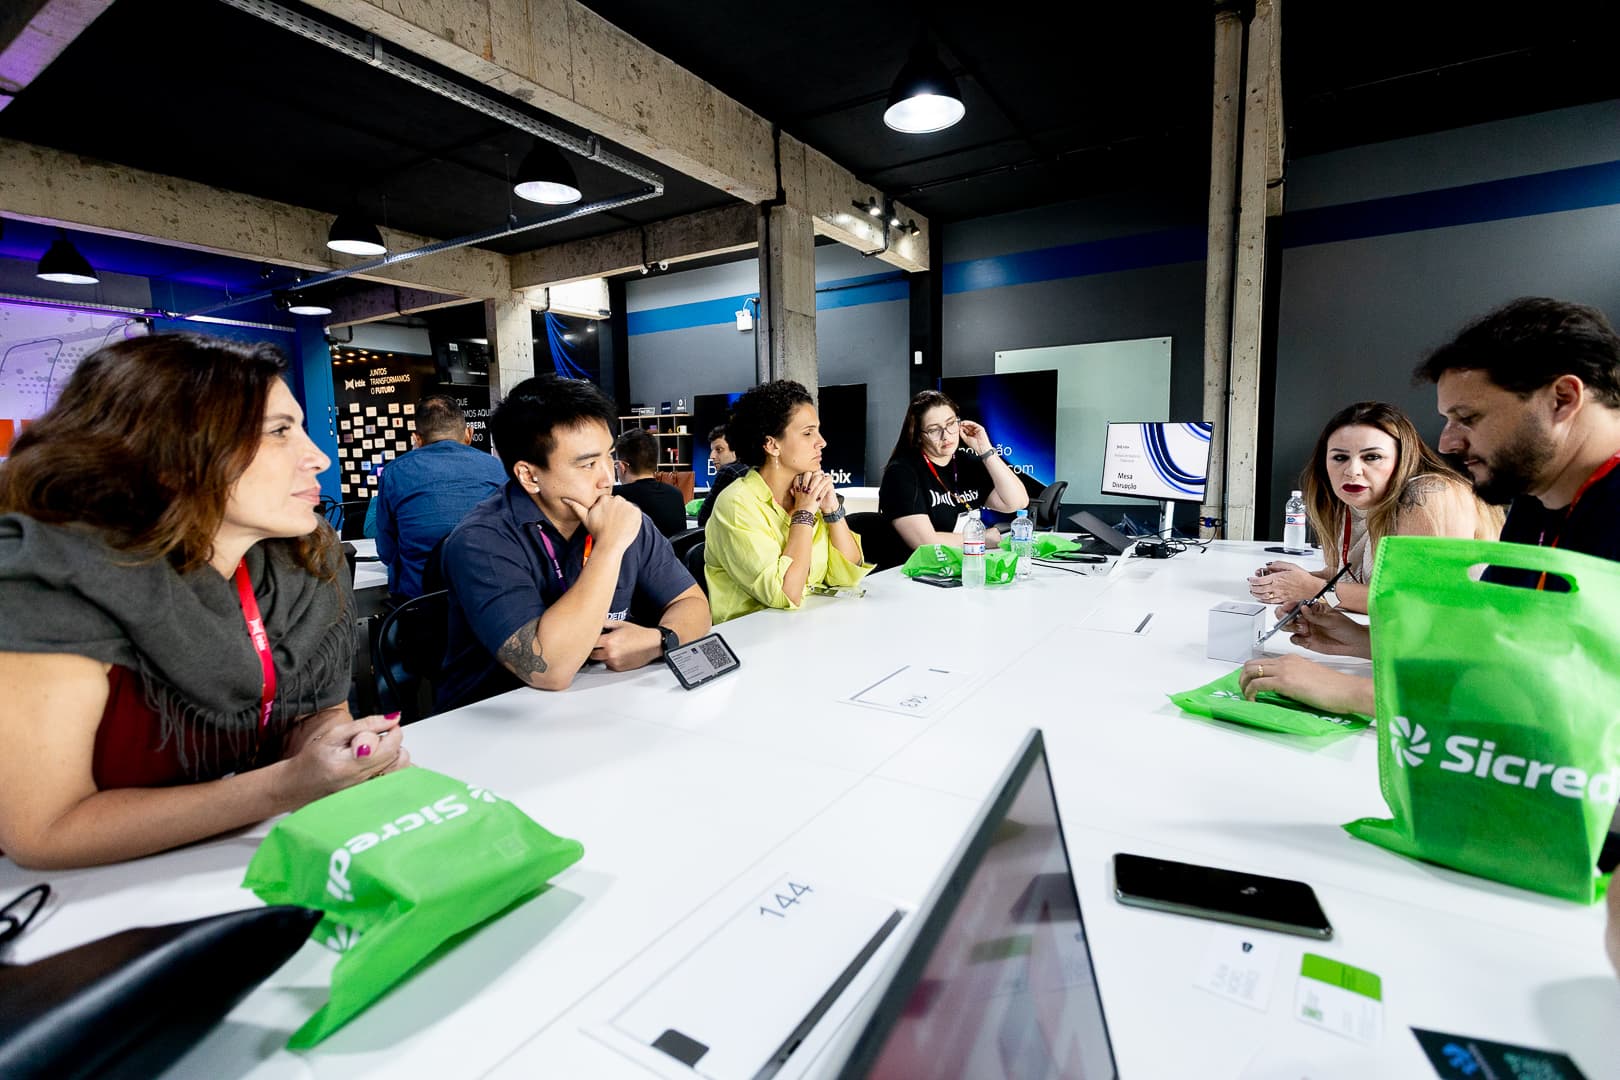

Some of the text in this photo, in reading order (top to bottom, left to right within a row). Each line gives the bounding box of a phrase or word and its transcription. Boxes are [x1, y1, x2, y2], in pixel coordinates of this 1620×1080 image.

[370, 368, 387, 376] JUNTOS
[370, 374, 410, 385] TRANSFORMAMOS
[375, 385, 395, 394] FUTURO
[478, 409, 490, 417] AQU
[1117, 472, 1133, 480] Mesa
[1440, 735, 1620, 804] Sicred
[760, 881, 814, 918] 144
